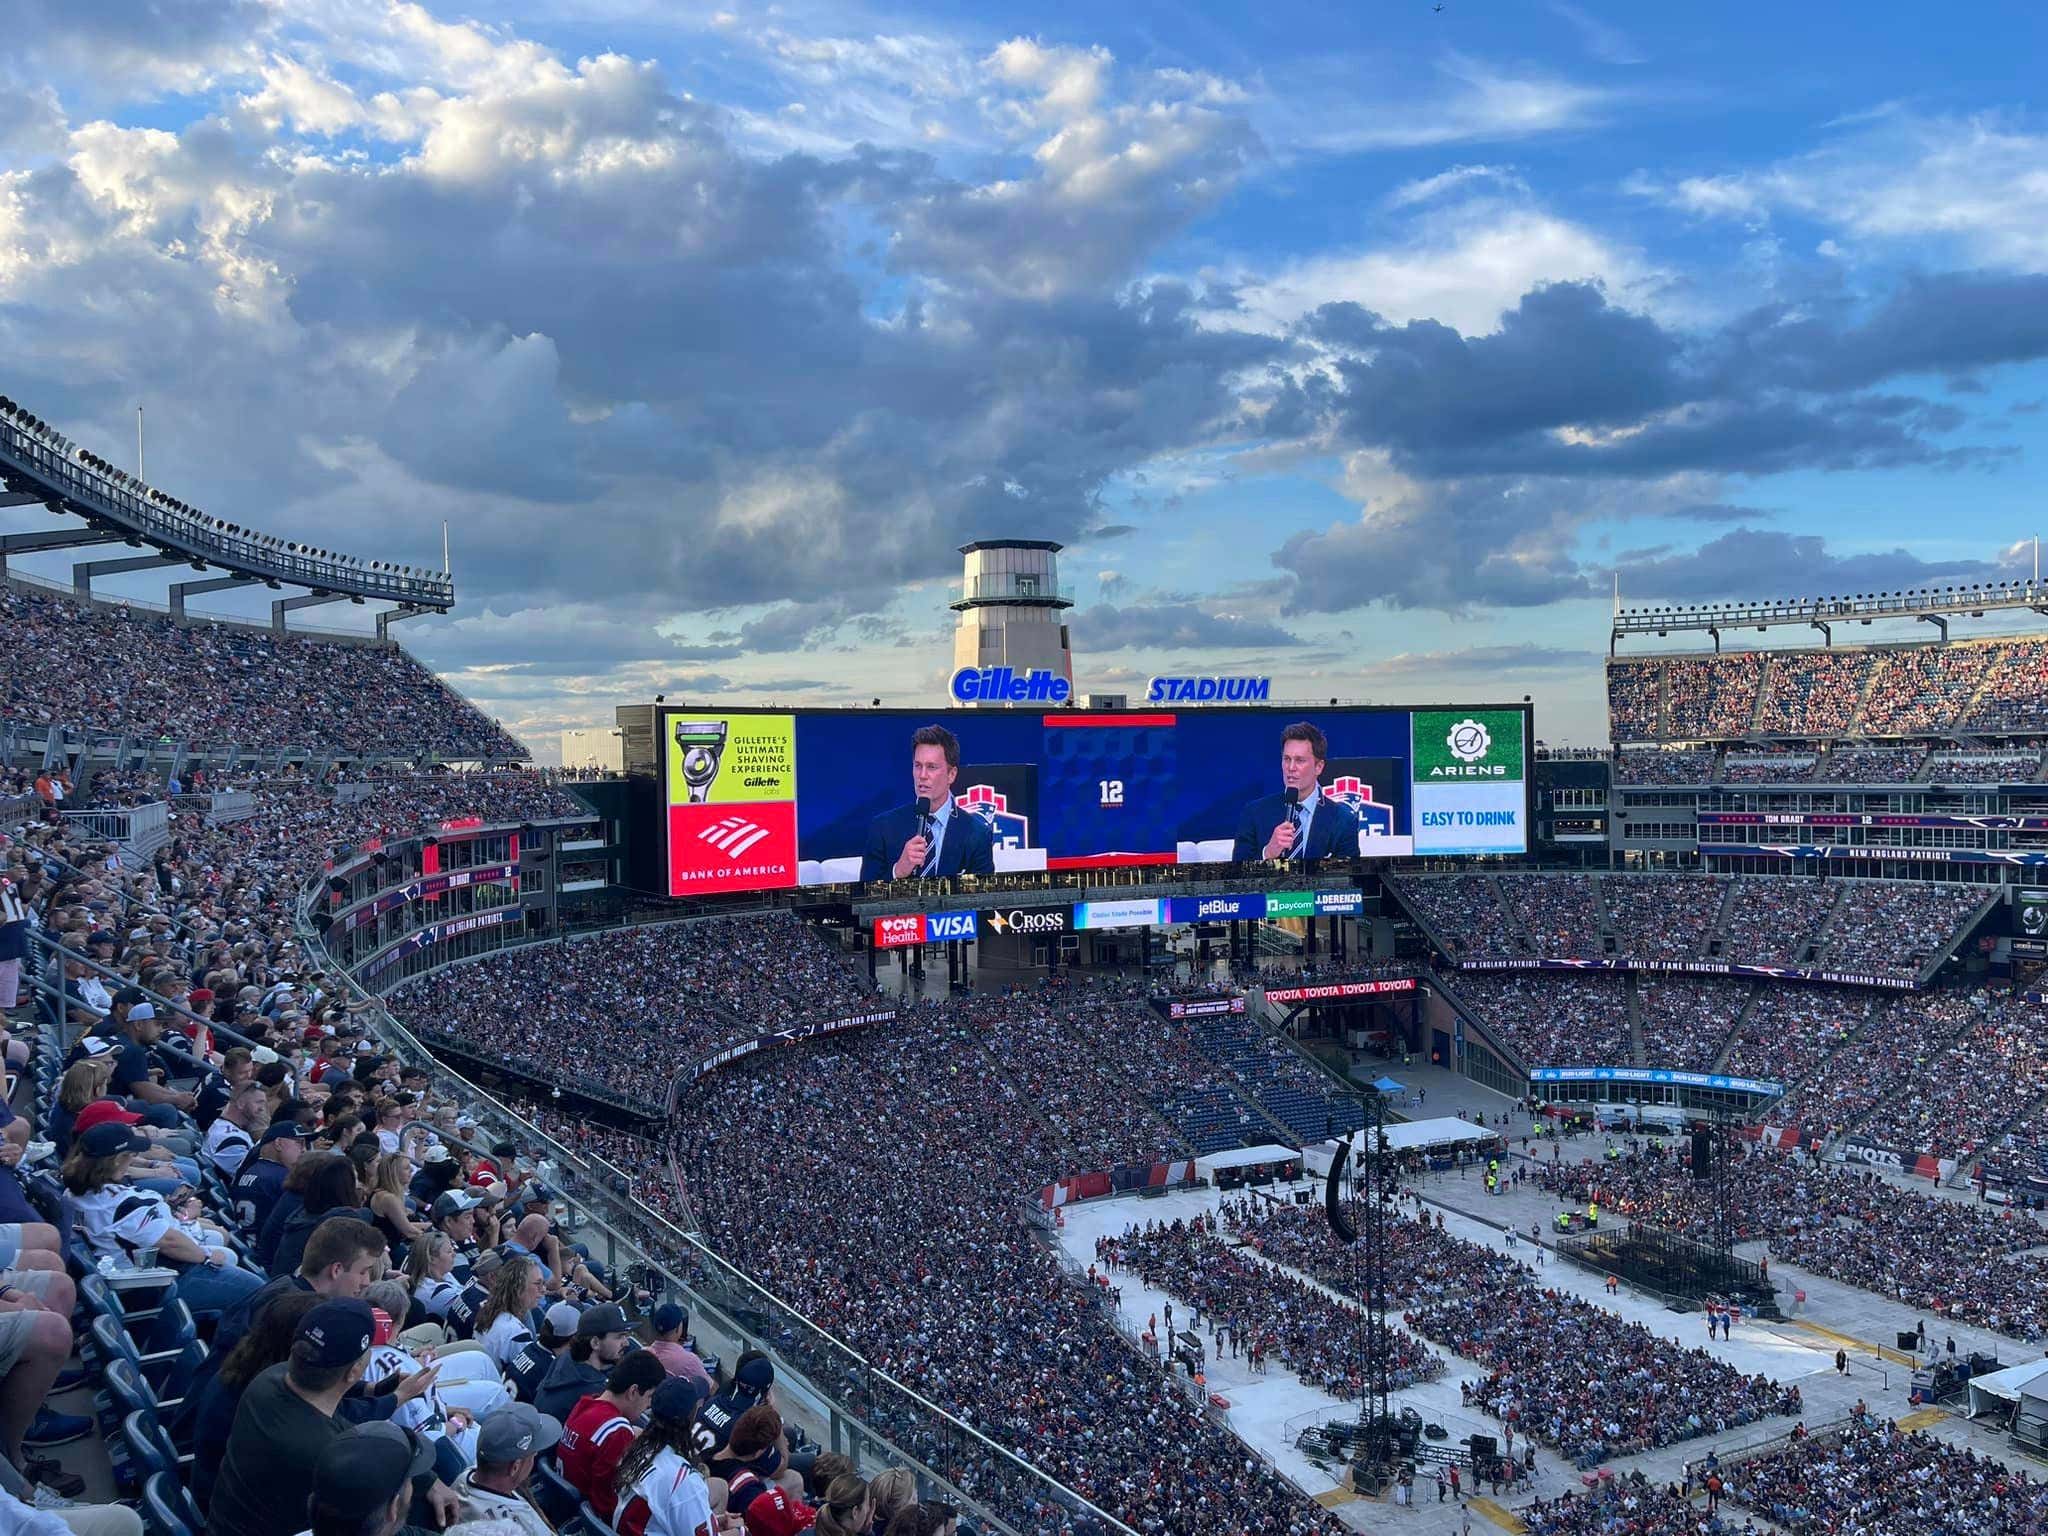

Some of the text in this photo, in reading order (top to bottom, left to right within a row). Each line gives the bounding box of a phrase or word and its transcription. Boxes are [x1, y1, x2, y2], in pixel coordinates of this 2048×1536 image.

[953, 667, 1069, 701] Gillette
[1150, 679, 1269, 701] STADIUM
[734, 736, 787, 745] GILLETTE'S
[737, 746, 785, 754] ULTIMATE
[737, 755, 785, 764] SHAVING
[731, 764, 792, 774] EXPERIENCE
[1429, 765, 1506, 776] ARIENS
[744, 778, 780, 787] Gillette
[1099, 780, 1124, 803] 12
[1422, 811, 1516, 826] EASY TO DRINK
[1764, 815, 1805, 824] TOM BRADY
[1861, 815, 1873, 825] 12
[1849, 848, 1951, 860] NEW ENGLAND PATRIOTS
[681, 864, 786, 881] BANK OF AMERICA
[1198, 899, 1239, 917] jetBlue
[1278, 902, 1312, 912] paycom
[893, 917, 918, 931] CVS
[928, 915, 975, 937] VISA
[1008, 910, 1064, 930] CROSS
[883, 930, 918, 944] Health
[1508, 960, 1541, 968] PATRIOTS
[1627, 961, 1730, 973] HALL OF FAME INDUCTION
[1822, 972, 1838, 981] NEW
[1877, 978, 1914, 989] PATRIOTS
[1265, 979, 1412, 1001] TOYOTA TOYOTA TOYOTA TOYOTA
[866, 1010, 896, 1024] PATRIOTS
[375, 1352, 402, 1374] 12
[704, 1404, 731, 1428] BRADY
